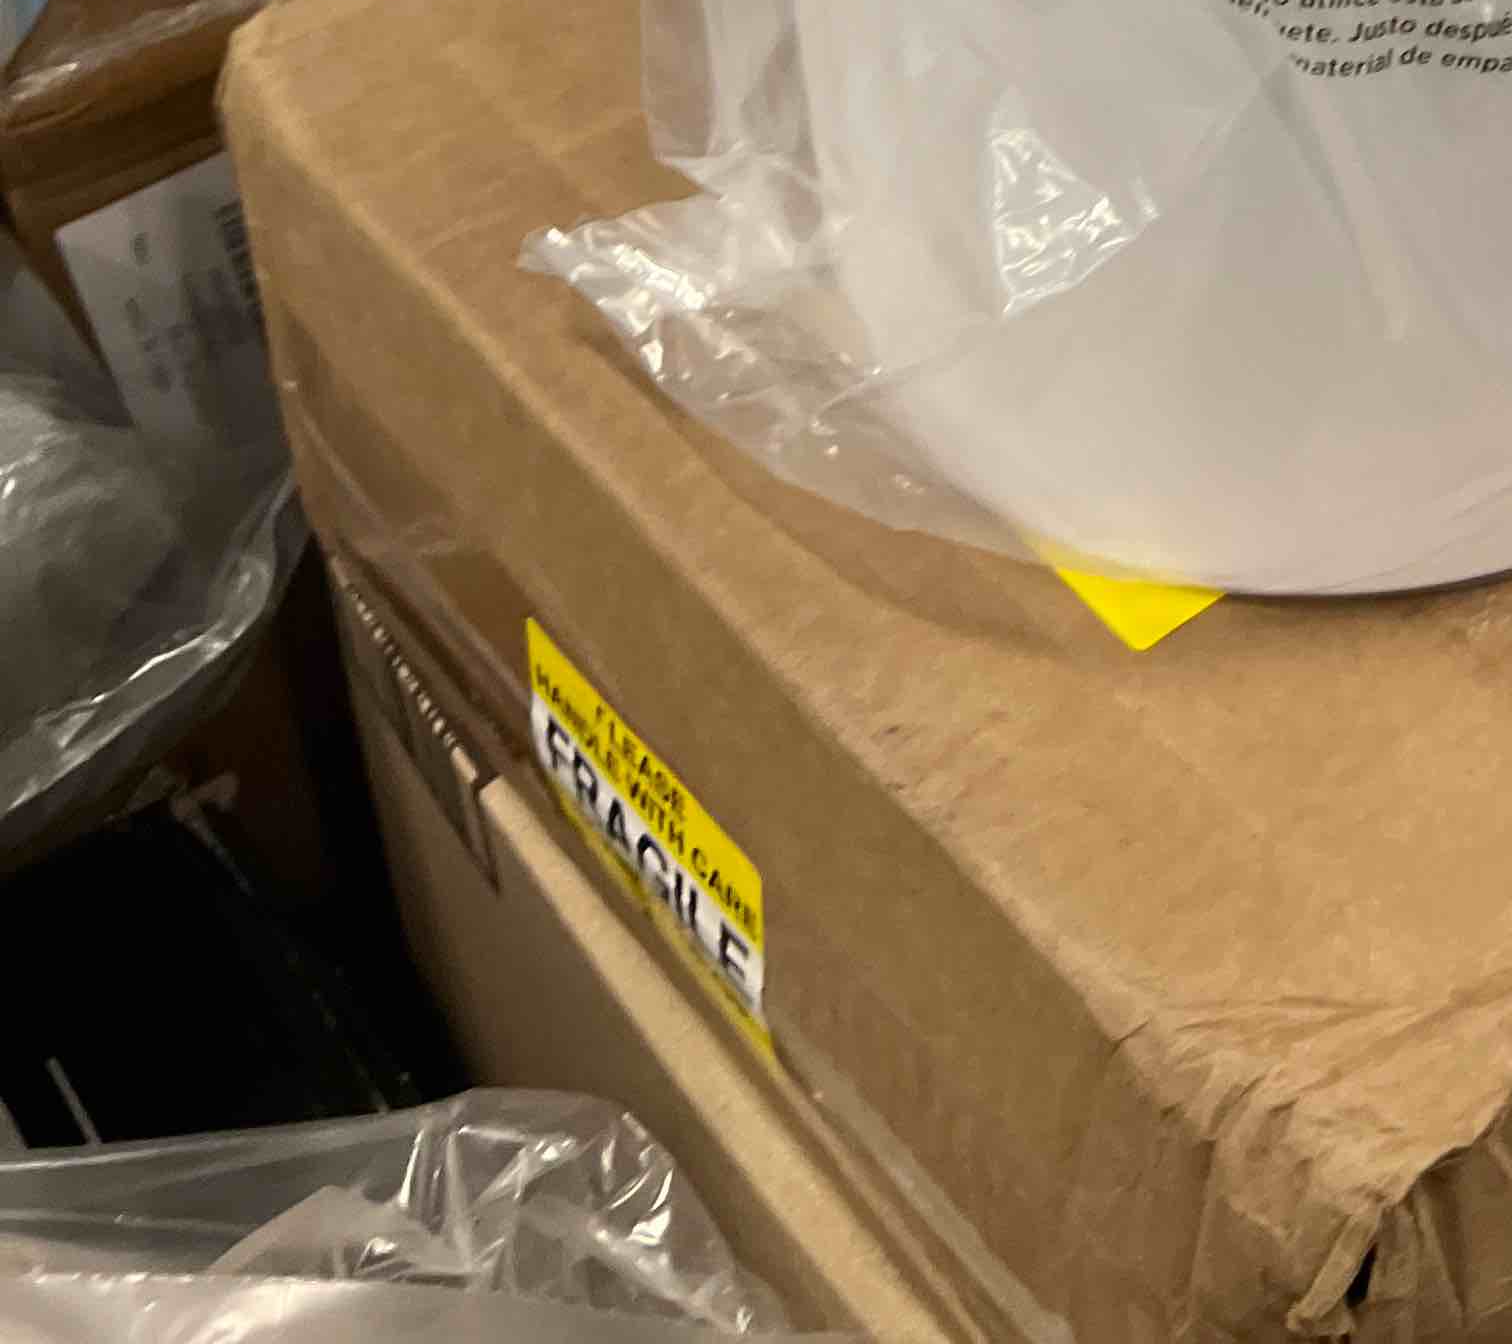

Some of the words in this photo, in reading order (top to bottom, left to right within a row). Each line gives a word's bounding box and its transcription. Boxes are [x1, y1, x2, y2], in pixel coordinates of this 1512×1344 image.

[1347, 15, 1419, 43] Justo
[1399, 44, 1433, 66] de
[545, 712, 752, 987] FRAGILE
